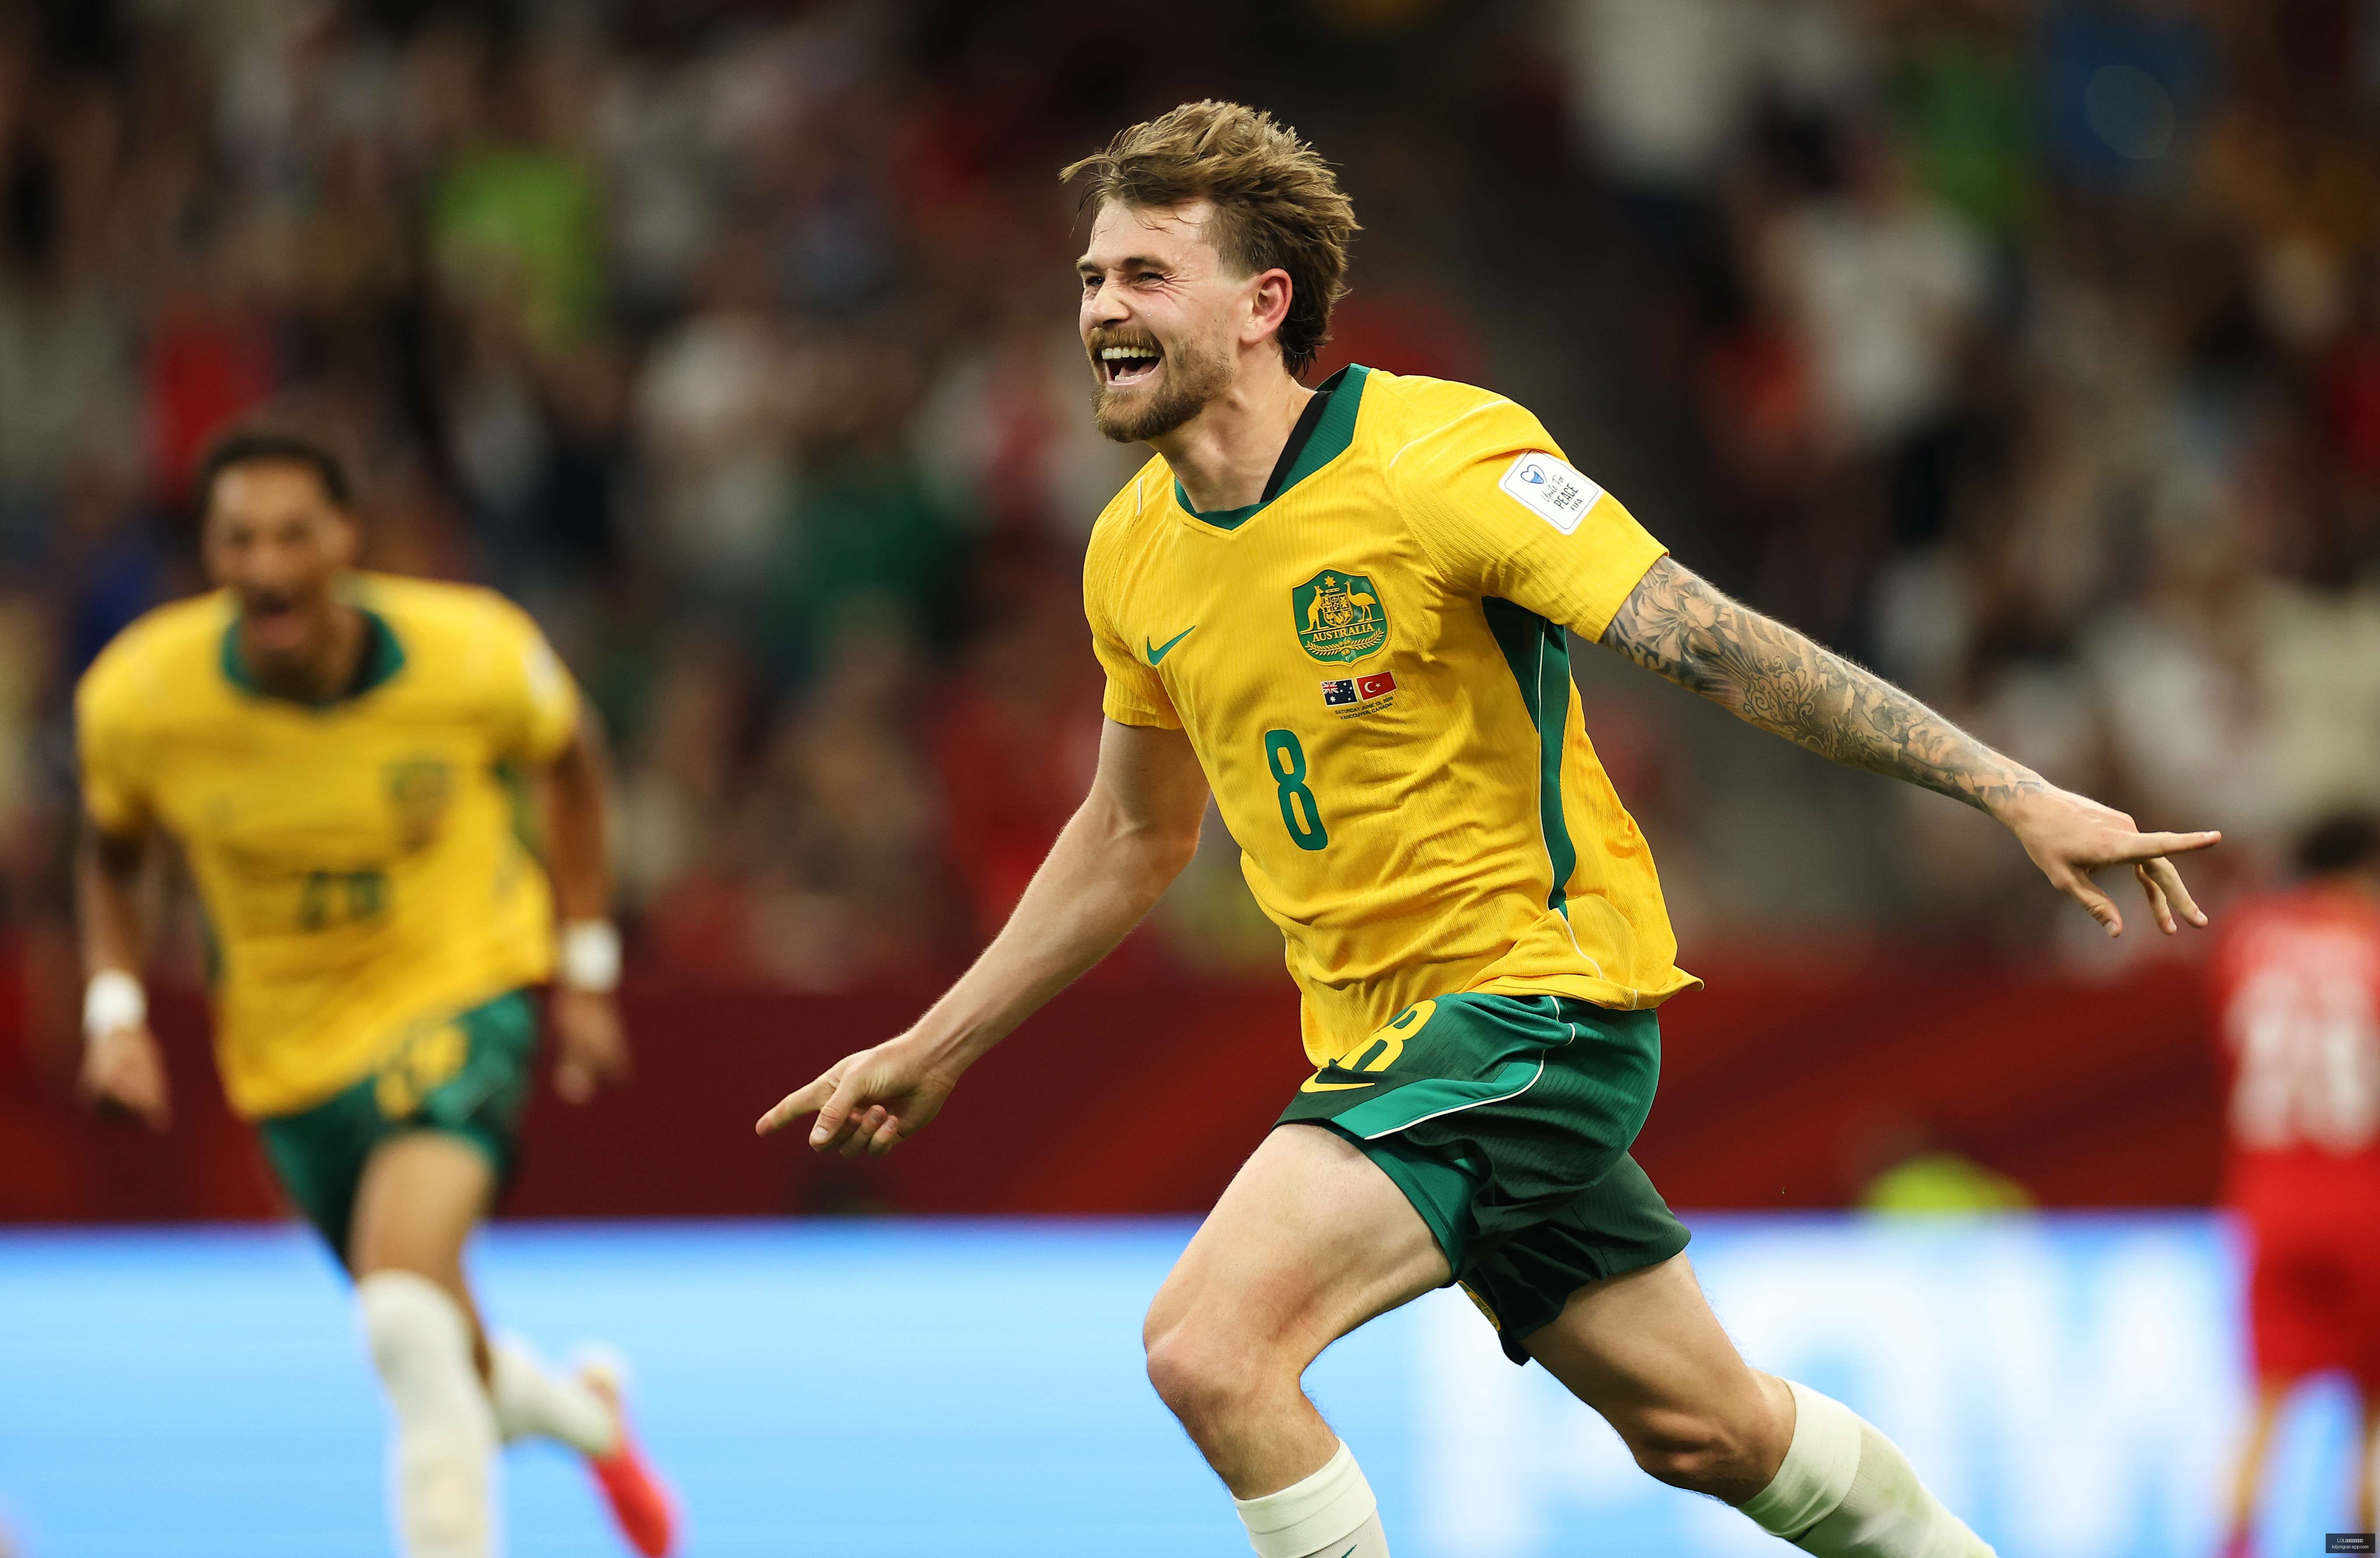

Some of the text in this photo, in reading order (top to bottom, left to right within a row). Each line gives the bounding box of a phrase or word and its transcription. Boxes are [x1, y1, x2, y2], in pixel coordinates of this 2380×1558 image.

[1540, 485, 1558, 502] Unite
[1554, 483, 1578, 509] PEACE
[1570, 499, 1582, 511] FIFA
[1312, 623, 1375, 642] AUSTRALIA
[1372, 703, 1392, 713] CANADA
[1265, 729, 1328, 851] 8
